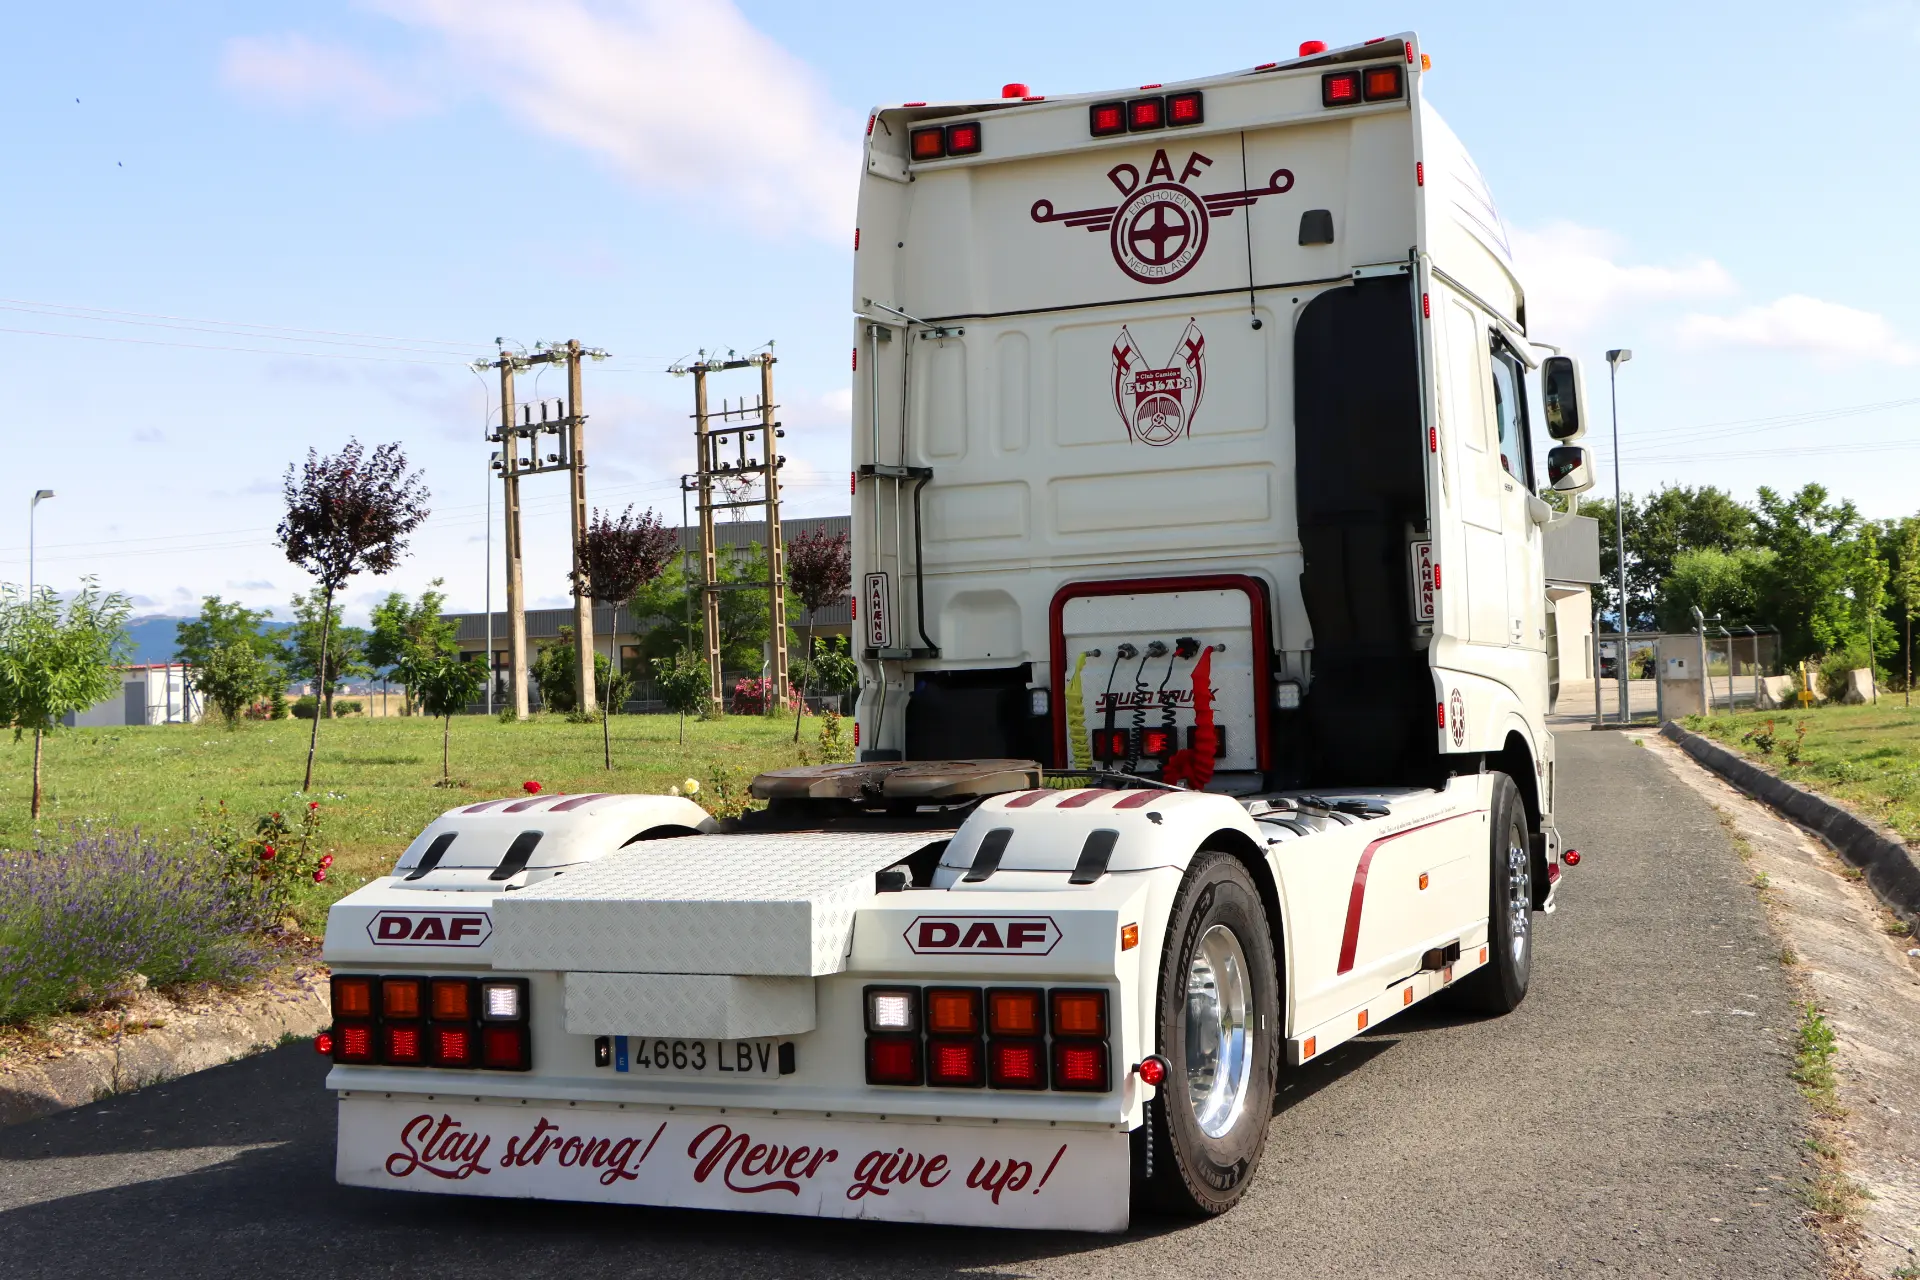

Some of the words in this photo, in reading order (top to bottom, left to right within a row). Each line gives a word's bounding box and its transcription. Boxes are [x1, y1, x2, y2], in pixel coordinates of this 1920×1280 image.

[1107, 149, 1214, 198] DAF
[1128, 191, 1191, 216] EINDHOVEN
[1127, 250, 1192, 277] NEDERLAND
[1157, 688, 1220, 704] TRUK
[377, 916, 483, 941] DAF
[918, 922, 1047, 949] DAF
[635, 1038, 707, 1071] 4663
[717, 1041, 772, 1074] LBV
[385, 1113, 492, 1180] Stay
[499, 1116, 668, 1186] strong!
[687, 1123, 839, 1198] Never
[846, 1146, 952, 1201] give
[965, 1143, 1068, 1206] up!
